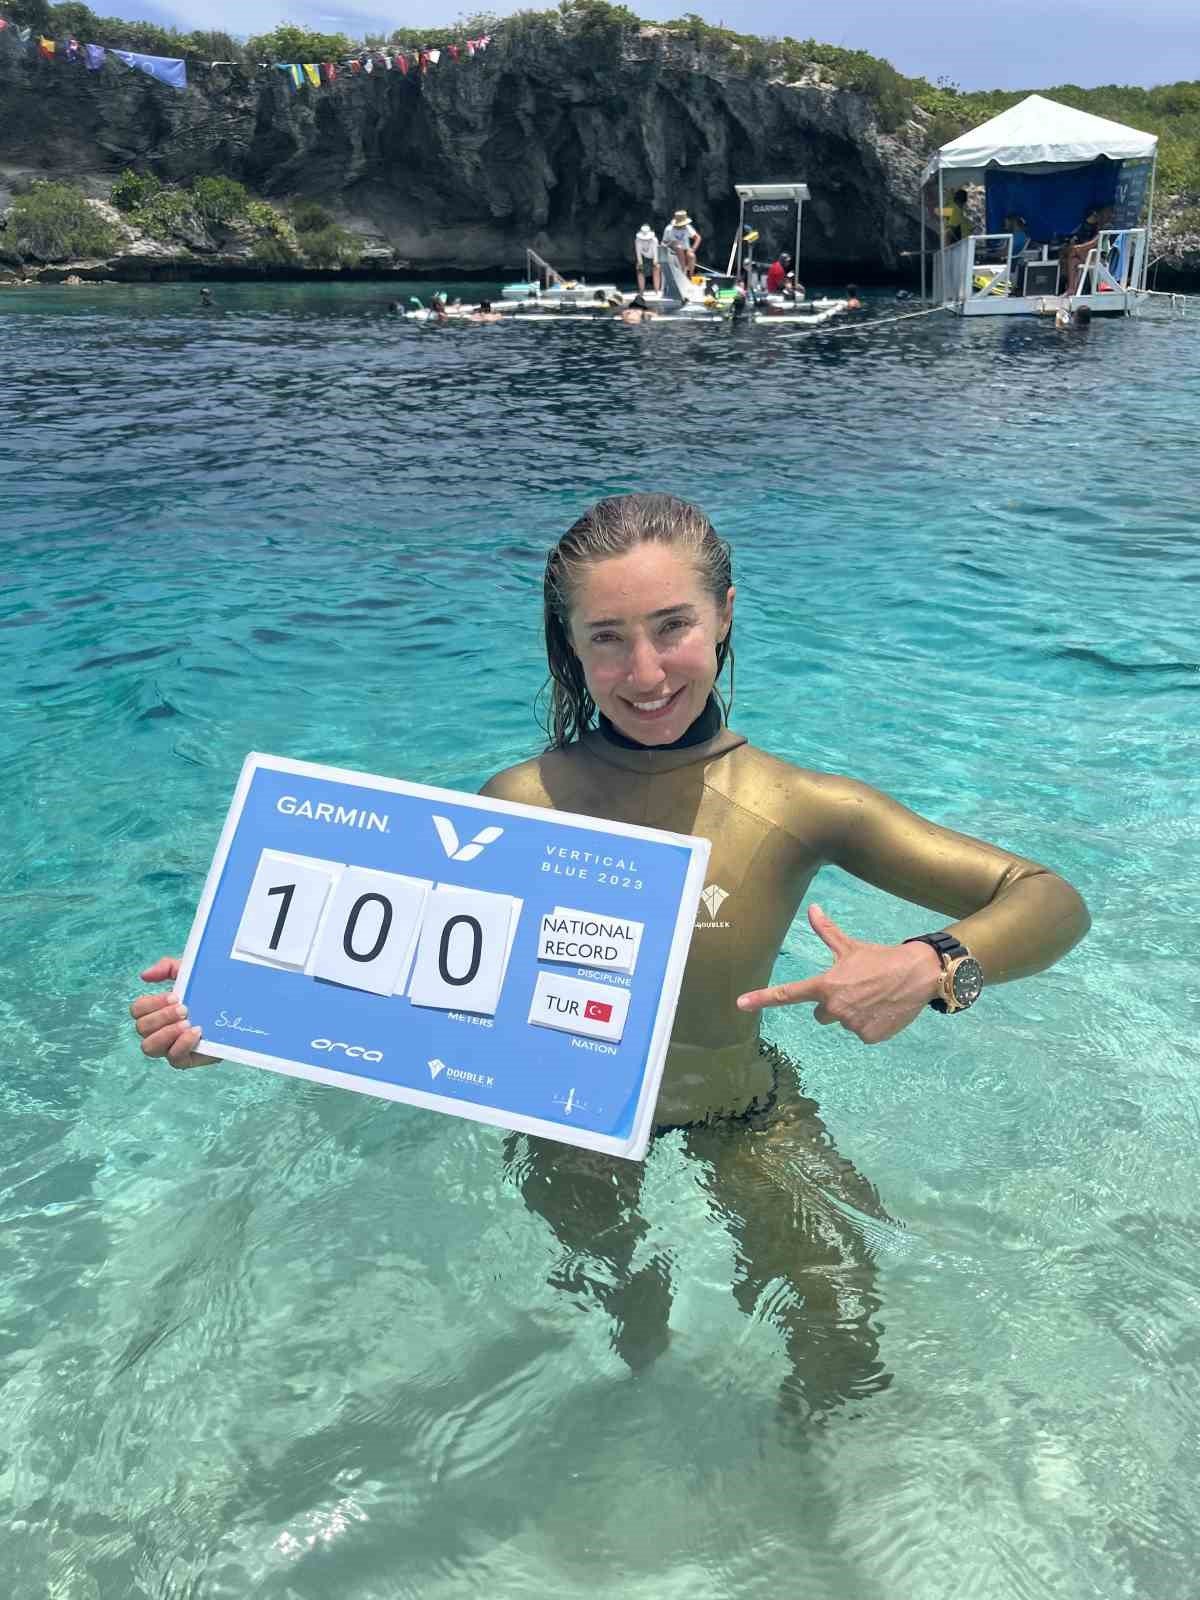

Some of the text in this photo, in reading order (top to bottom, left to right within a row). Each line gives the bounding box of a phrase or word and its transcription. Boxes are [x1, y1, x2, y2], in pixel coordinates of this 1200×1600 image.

[276, 795, 388, 833] GARMIN
[545, 845, 638, 872] VERTICAL
[541, 861, 643, 890] BLUE 2023
[543, 917, 634, 940] NATIONAL
[545, 940, 618, 961] RECORD
[577, 968, 632, 986] DISCIPLINE
[546, 995, 580, 1016] TUR
[447, 1012, 494, 1028] METERS
[310, 1038, 384, 1063] orca
[571, 1038, 617, 1055] NATION
